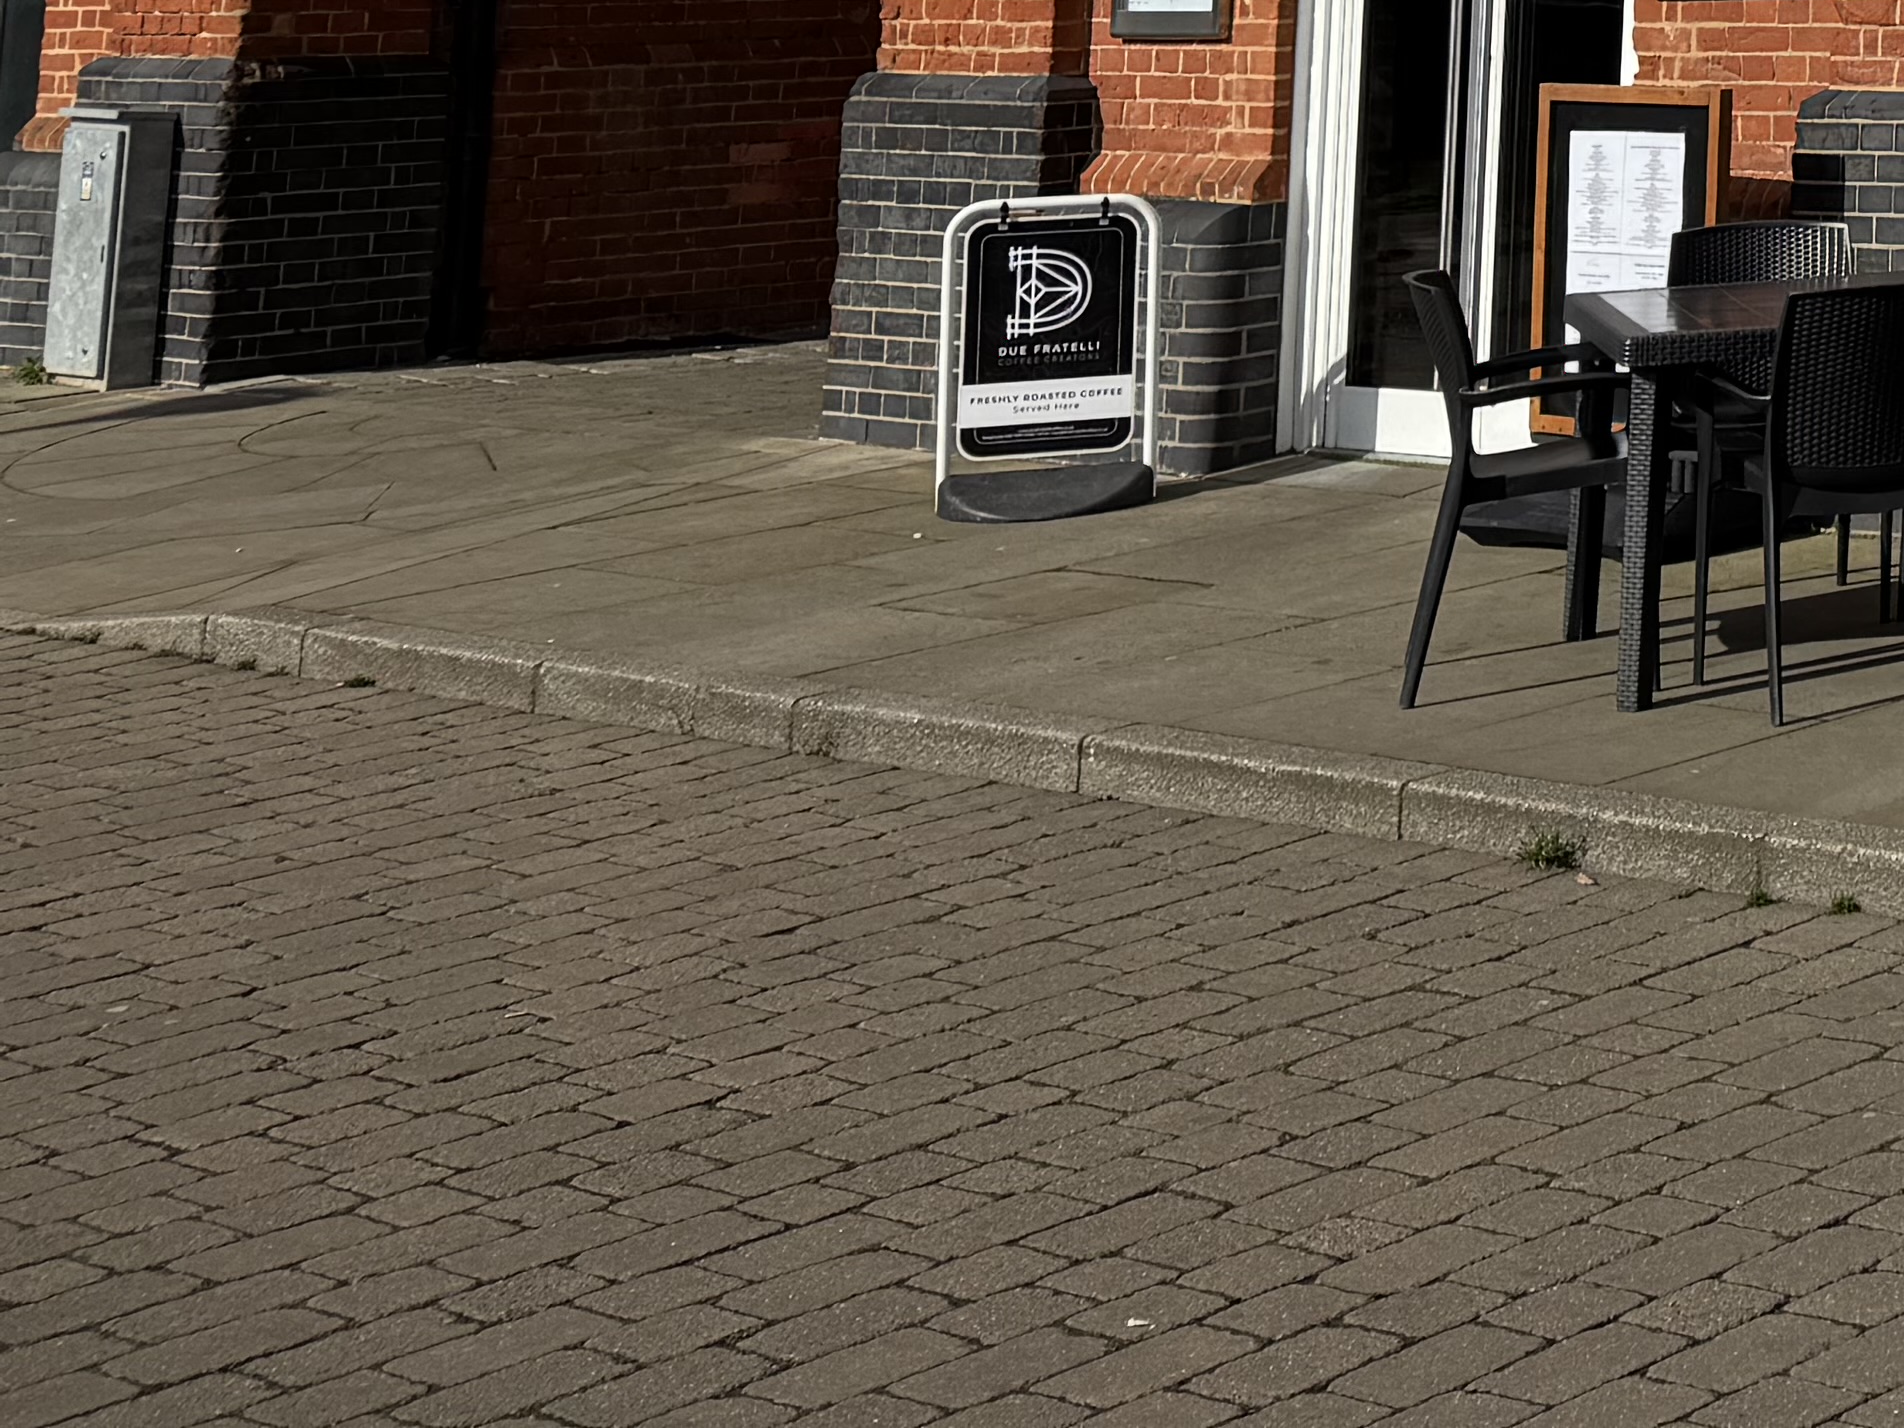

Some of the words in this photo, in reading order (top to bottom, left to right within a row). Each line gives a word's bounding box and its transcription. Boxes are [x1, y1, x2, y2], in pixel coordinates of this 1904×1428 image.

[998, 345, 1027, 357] DUE
[1034, 341, 1100, 354] FRATELLI
[998, 356, 1039, 366] COFFEE
[970, 395, 1019, 405] FRESHLY
[1023, 391, 1076, 401] ROASTED
[1080, 387, 1123, 398] COFFEE
[1013, 404, 1050, 414] Served
[1054, 403, 1080, 411] Here
